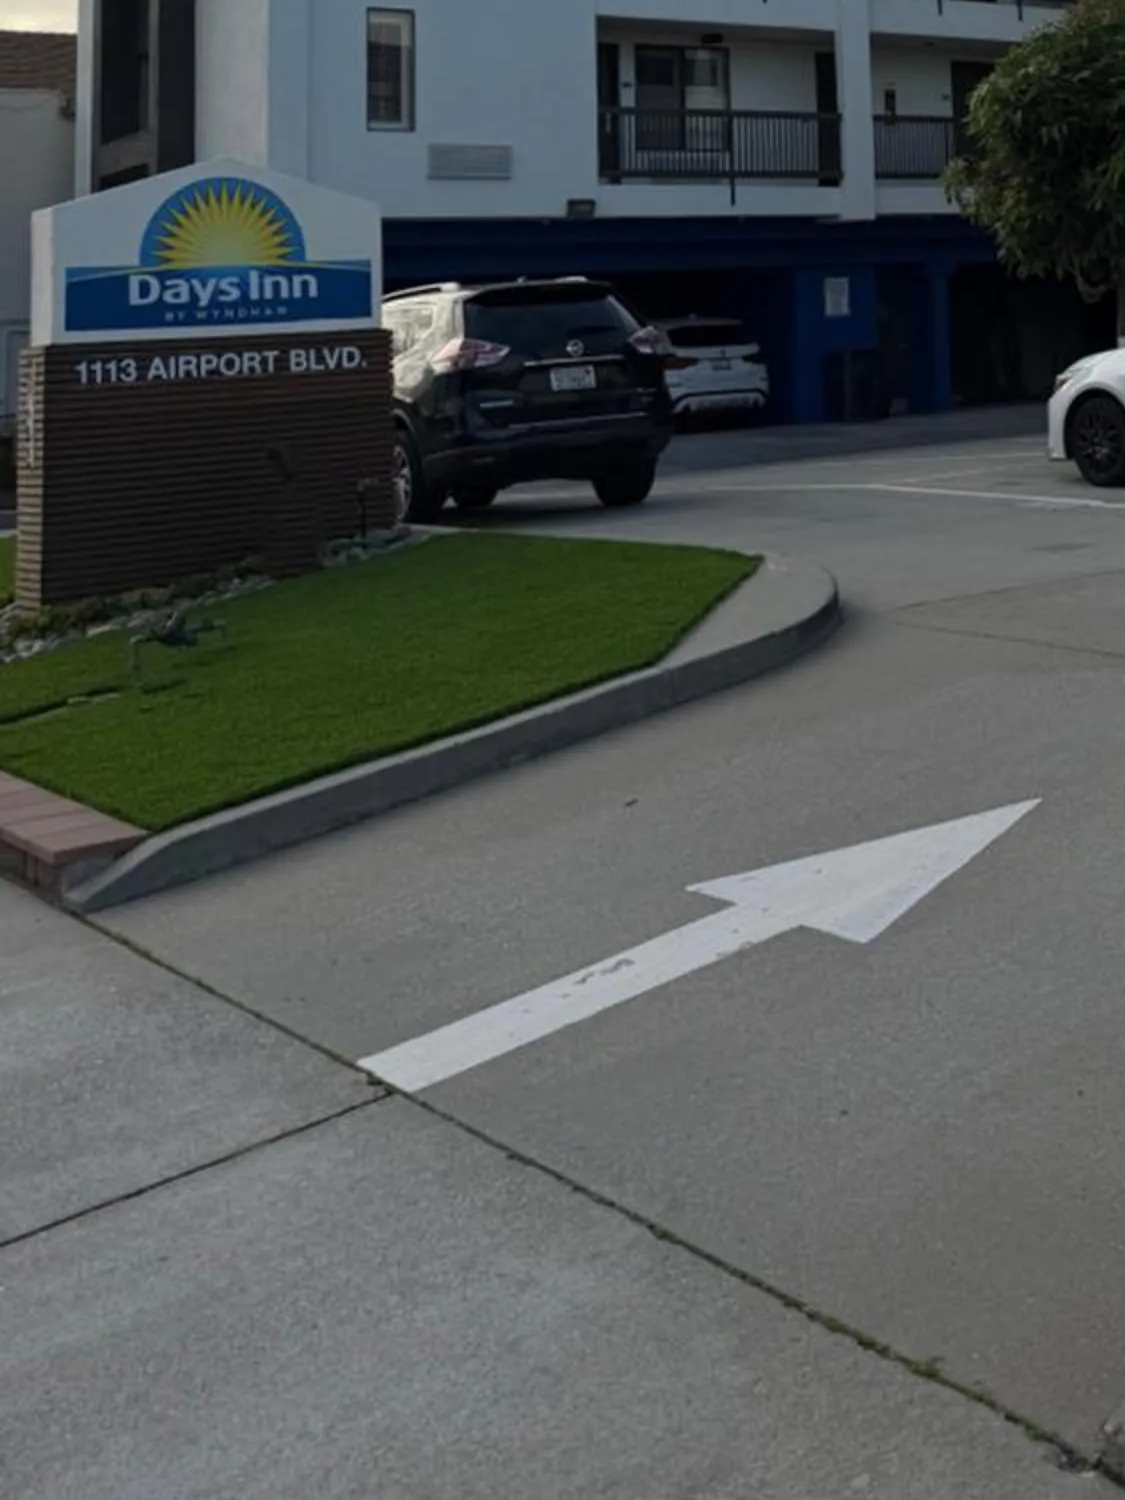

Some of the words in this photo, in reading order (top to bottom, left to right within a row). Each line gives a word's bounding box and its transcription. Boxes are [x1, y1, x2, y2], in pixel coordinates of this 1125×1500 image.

[128, 273, 241, 307] Days
[249, 268, 319, 300] Inn
[164, 310, 187, 322] BY
[195, 306, 288, 320] WYNDHAM
[74, 357, 138, 384] 1113
[147, 350, 281, 380] AIRPORT
[289, 345, 368, 373] BLVD.
